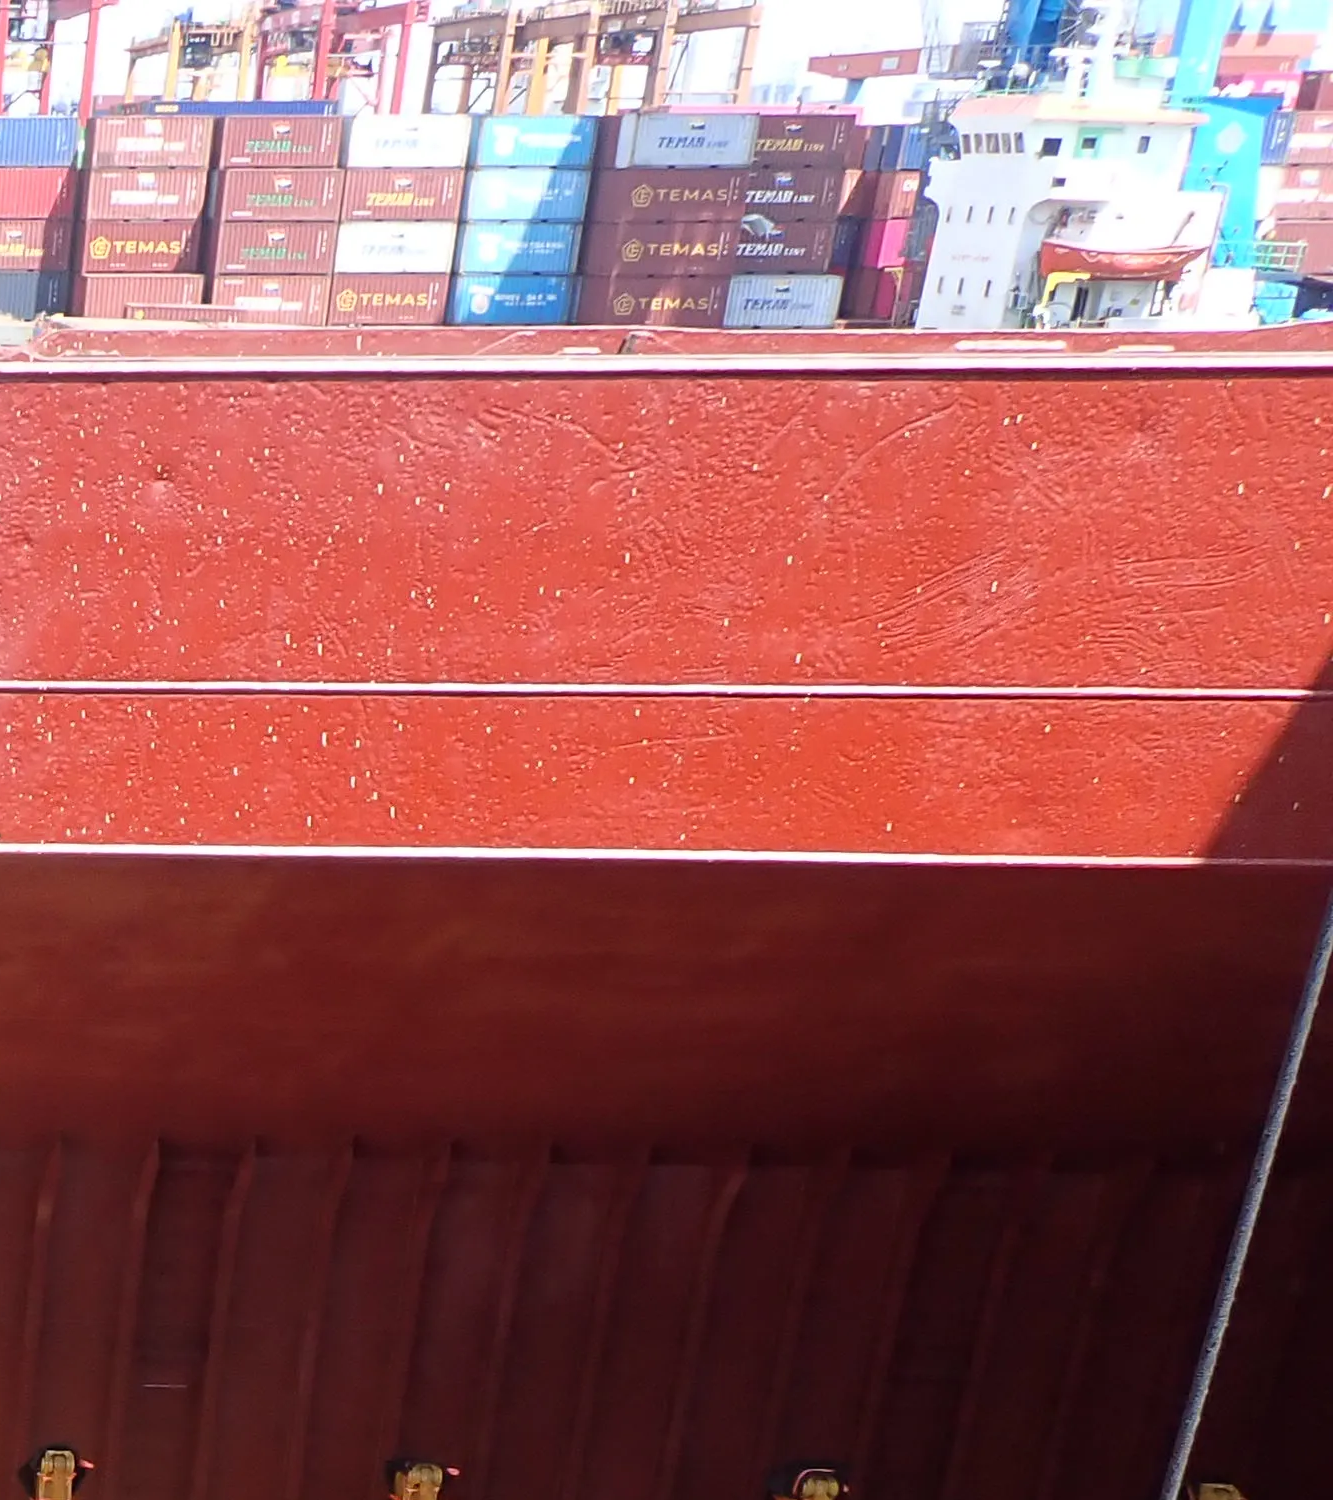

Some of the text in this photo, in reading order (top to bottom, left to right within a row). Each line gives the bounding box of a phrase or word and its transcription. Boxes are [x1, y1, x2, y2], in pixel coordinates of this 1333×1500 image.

[657, 188, 728, 201] TEMAS
[113, 240, 181, 254] TEMAS
[647, 243, 718, 256] TEMAS
[360, 293, 428, 306] TEMAS
[639, 297, 708, 310] TEMAS
